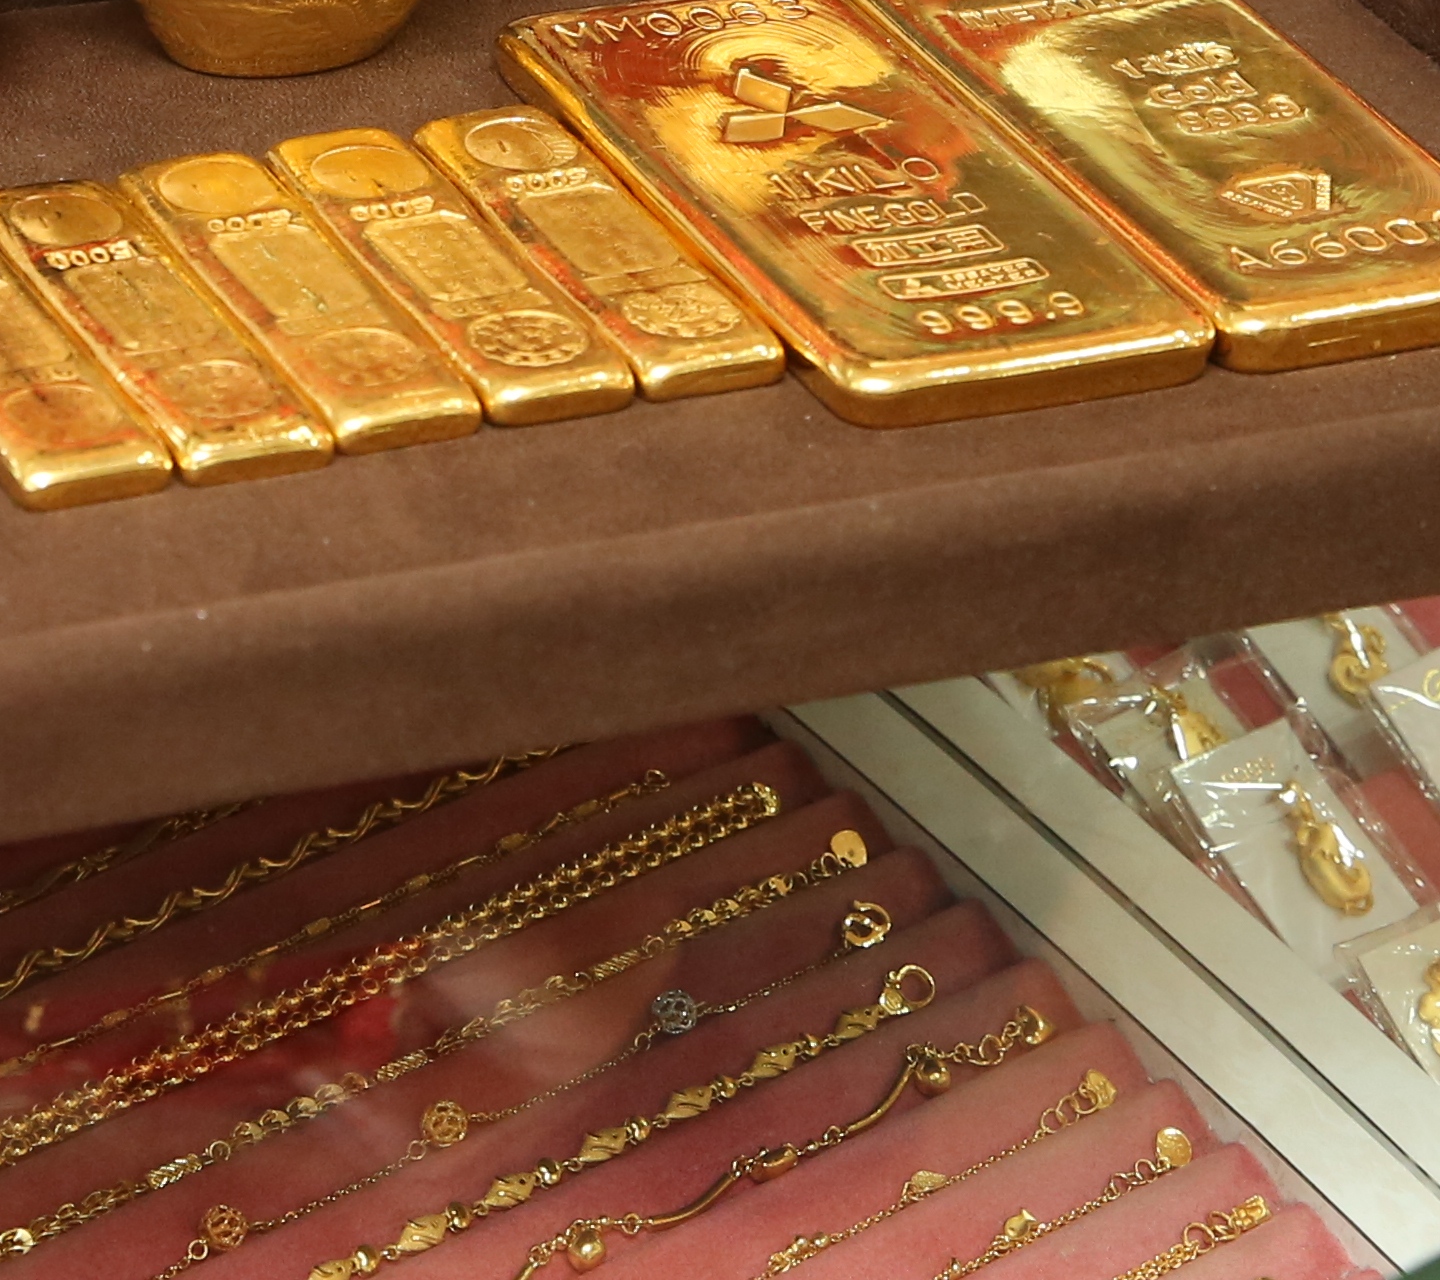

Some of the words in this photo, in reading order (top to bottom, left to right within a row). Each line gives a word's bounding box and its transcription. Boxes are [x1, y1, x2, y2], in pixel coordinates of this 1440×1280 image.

[1147, 71, 1259, 108] Gold
[1176, 94, 1303, 133] 999.9
[803, 157, 940, 196] KILO
[917, 291, 1085, 335] 999.9
